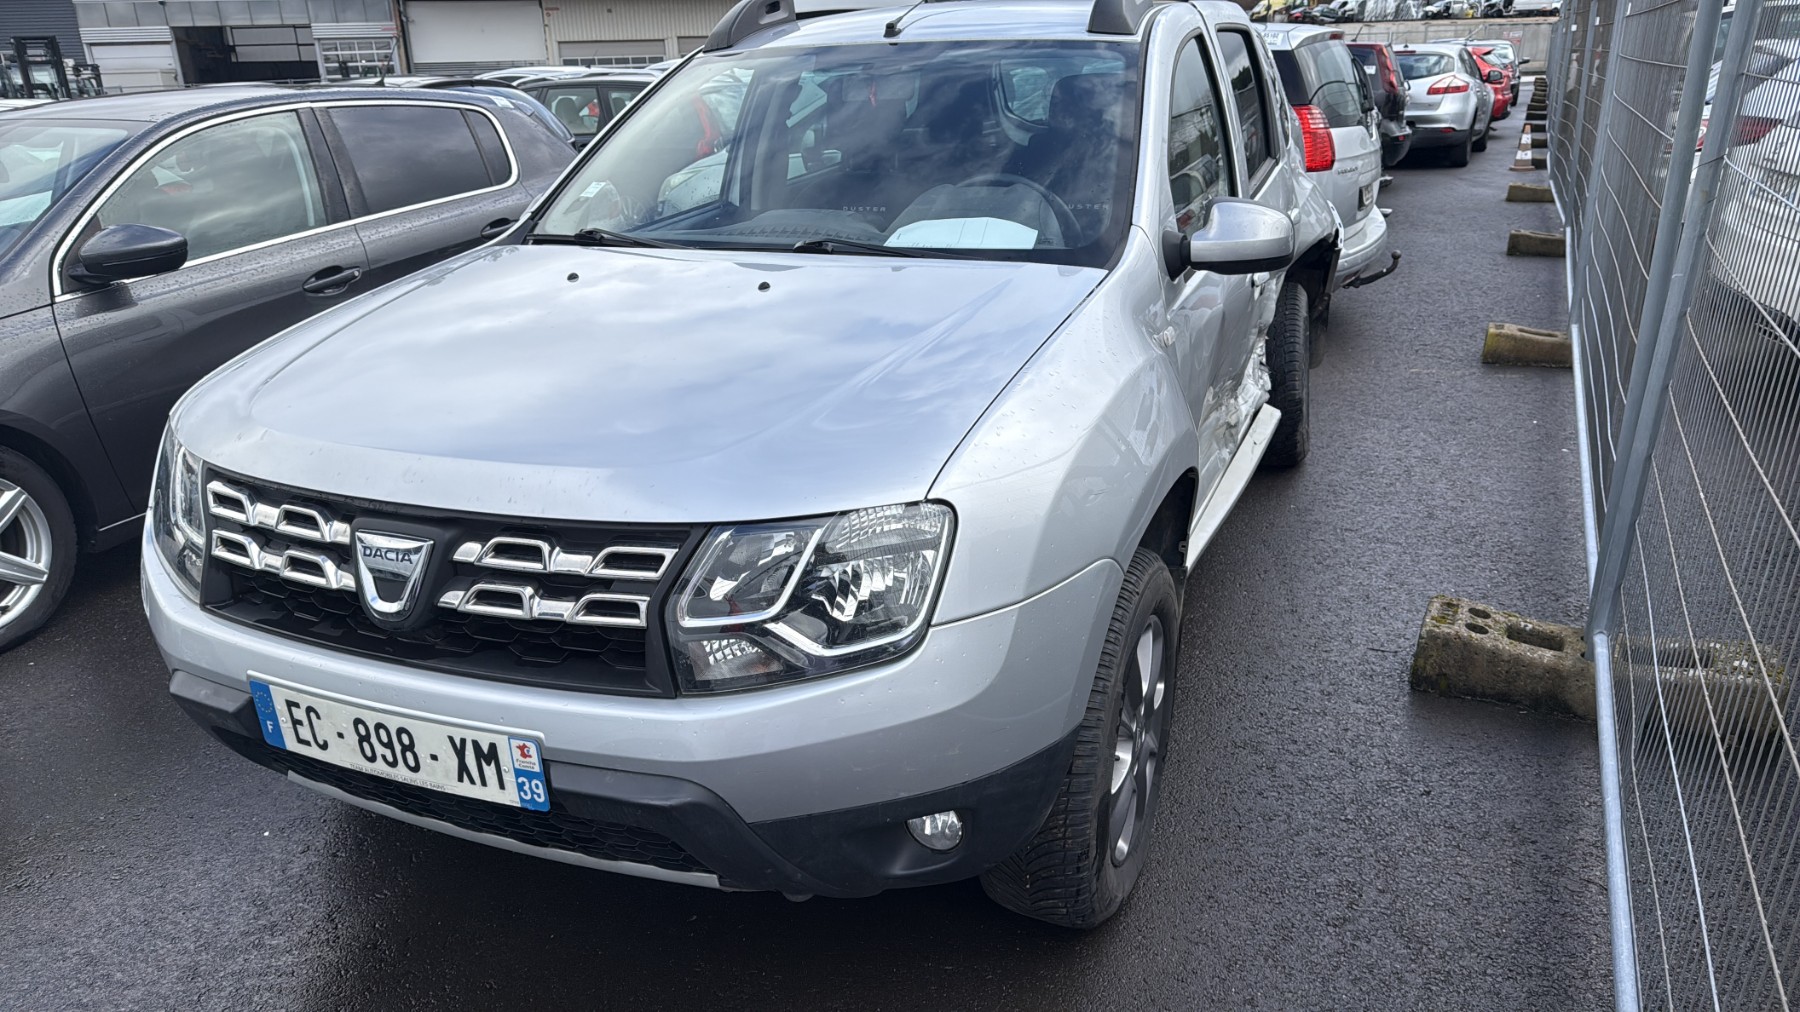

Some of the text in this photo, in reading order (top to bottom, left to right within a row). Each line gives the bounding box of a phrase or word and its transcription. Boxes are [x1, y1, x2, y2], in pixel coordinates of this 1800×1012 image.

[362, 545, 413, 564] DACIA
[266, 720, 274, 733] F
[518, 777, 545, 802] 39
